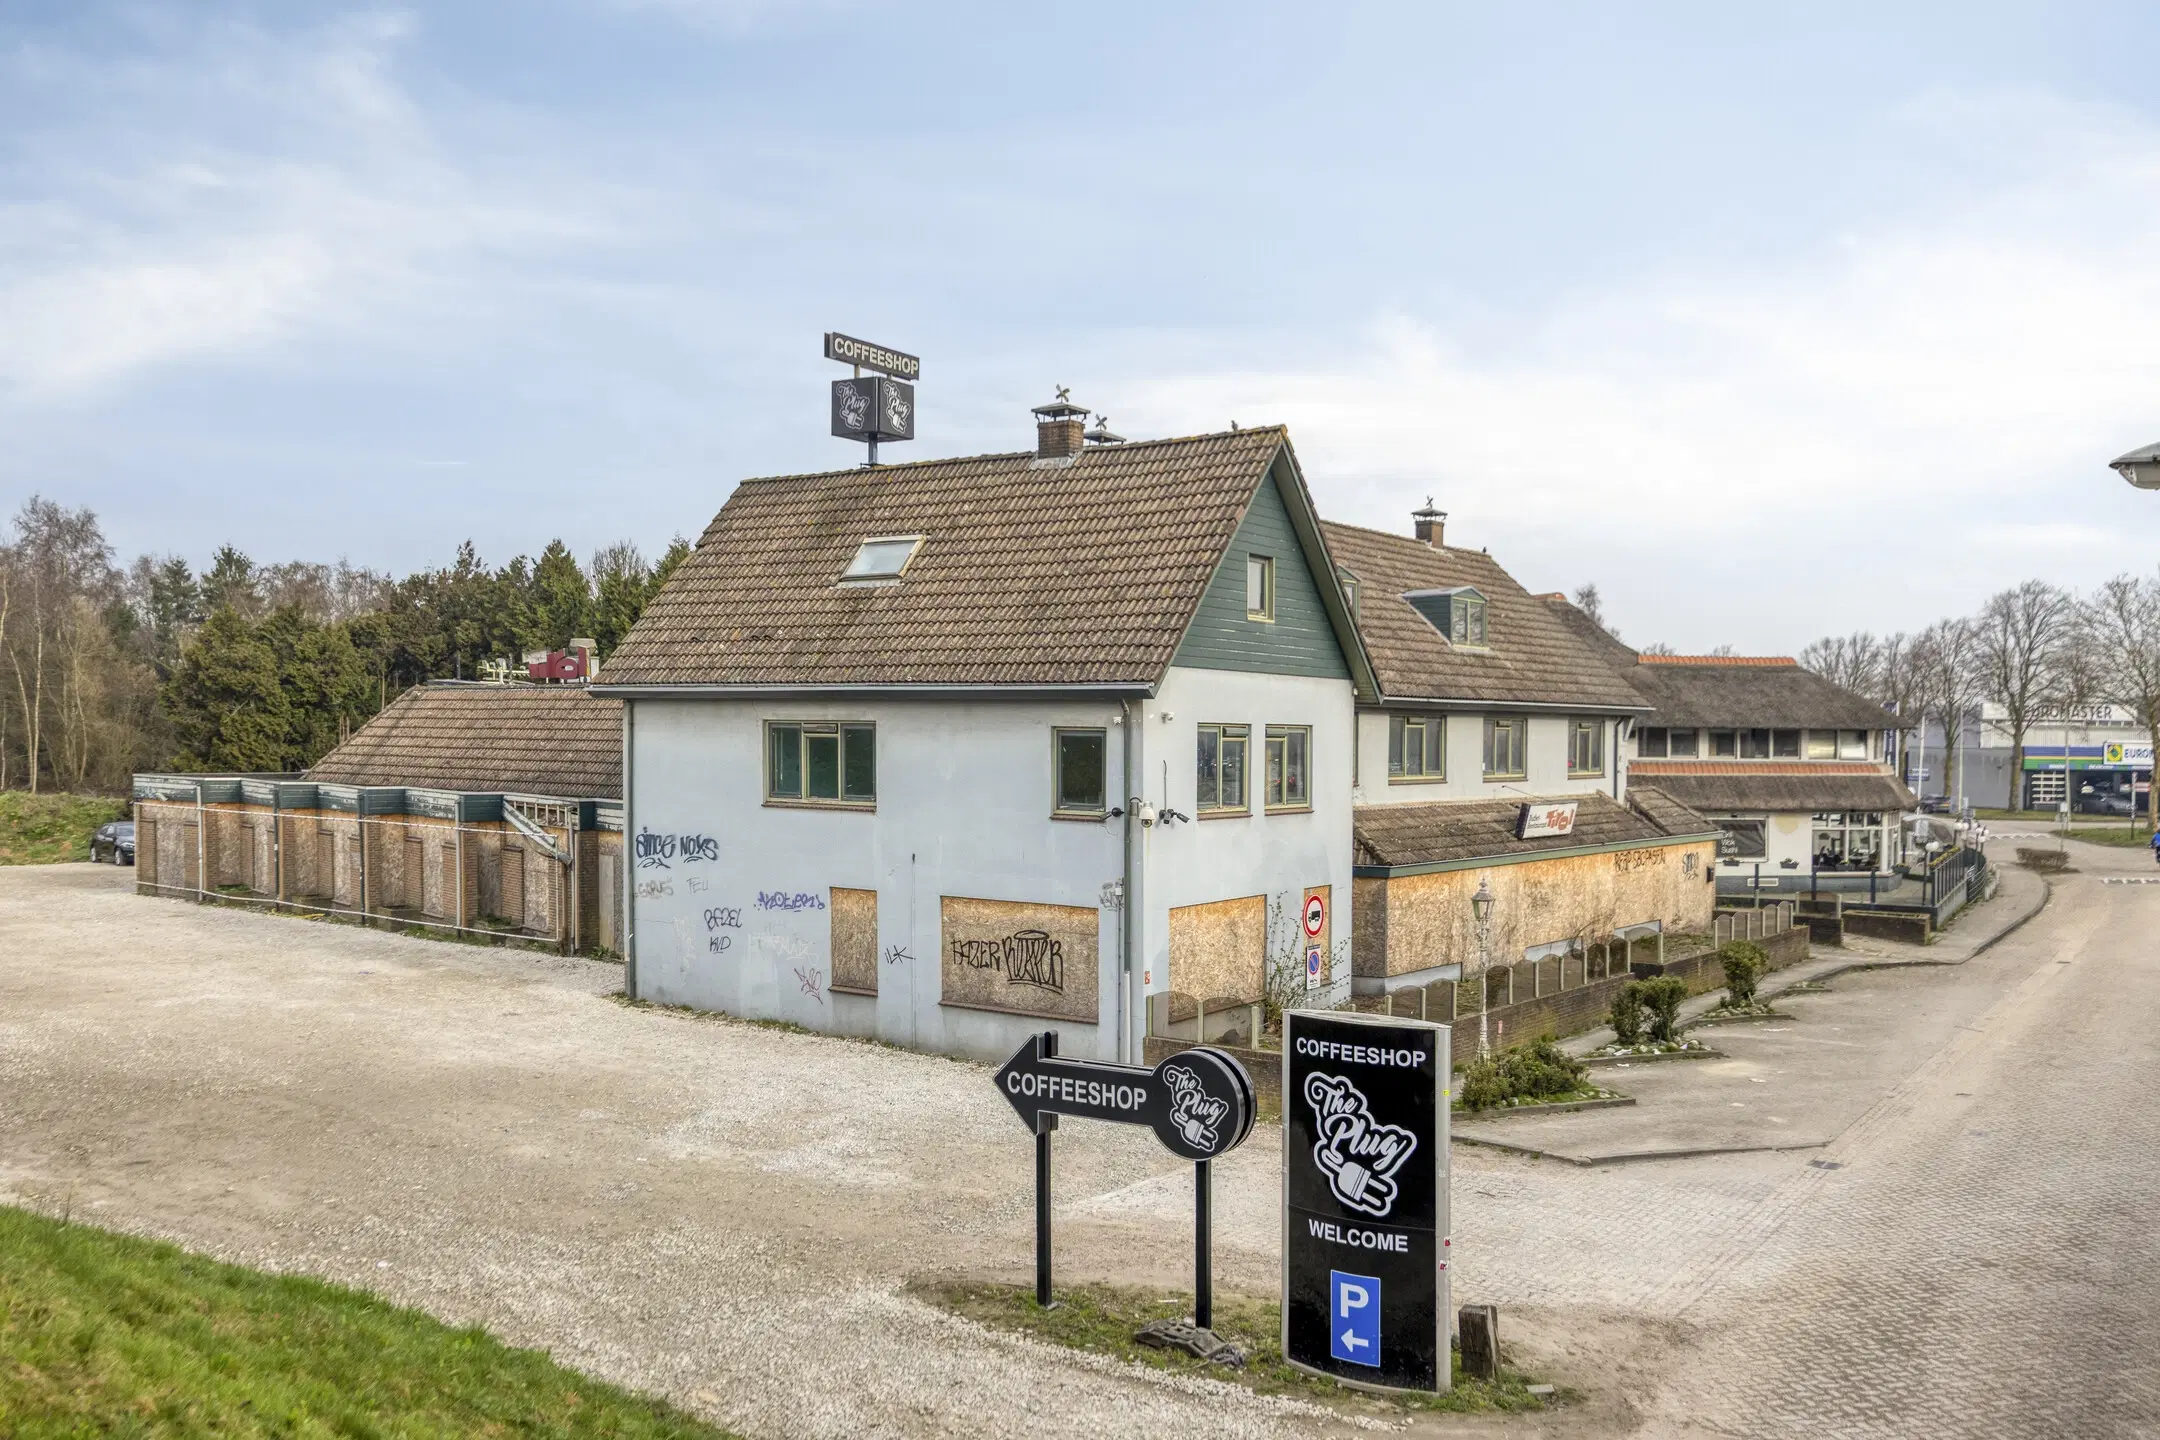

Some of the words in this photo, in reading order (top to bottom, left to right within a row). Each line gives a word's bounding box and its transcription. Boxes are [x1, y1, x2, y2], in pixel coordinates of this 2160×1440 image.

[834, 337, 919, 375] COFFEESHOP
[838, 384, 854, 397] The
[843, 395, 867, 414] Plug
[885, 384, 899, 397] The
[889, 396, 909, 414] Plug
[1296, 1037, 1427, 1068] COFFEESHOP
[1007, 1070, 1147, 1111] COFFEESHOP
[1167, 1069, 1197, 1091] The
[1311, 1079, 1358, 1115] The
[1176, 1089, 1224, 1124] Plug
[1325, 1113, 1405, 1171] Plug
[1308, 1218, 1409, 1253] WELCOME
[1340, 1281, 1369, 1318] P
